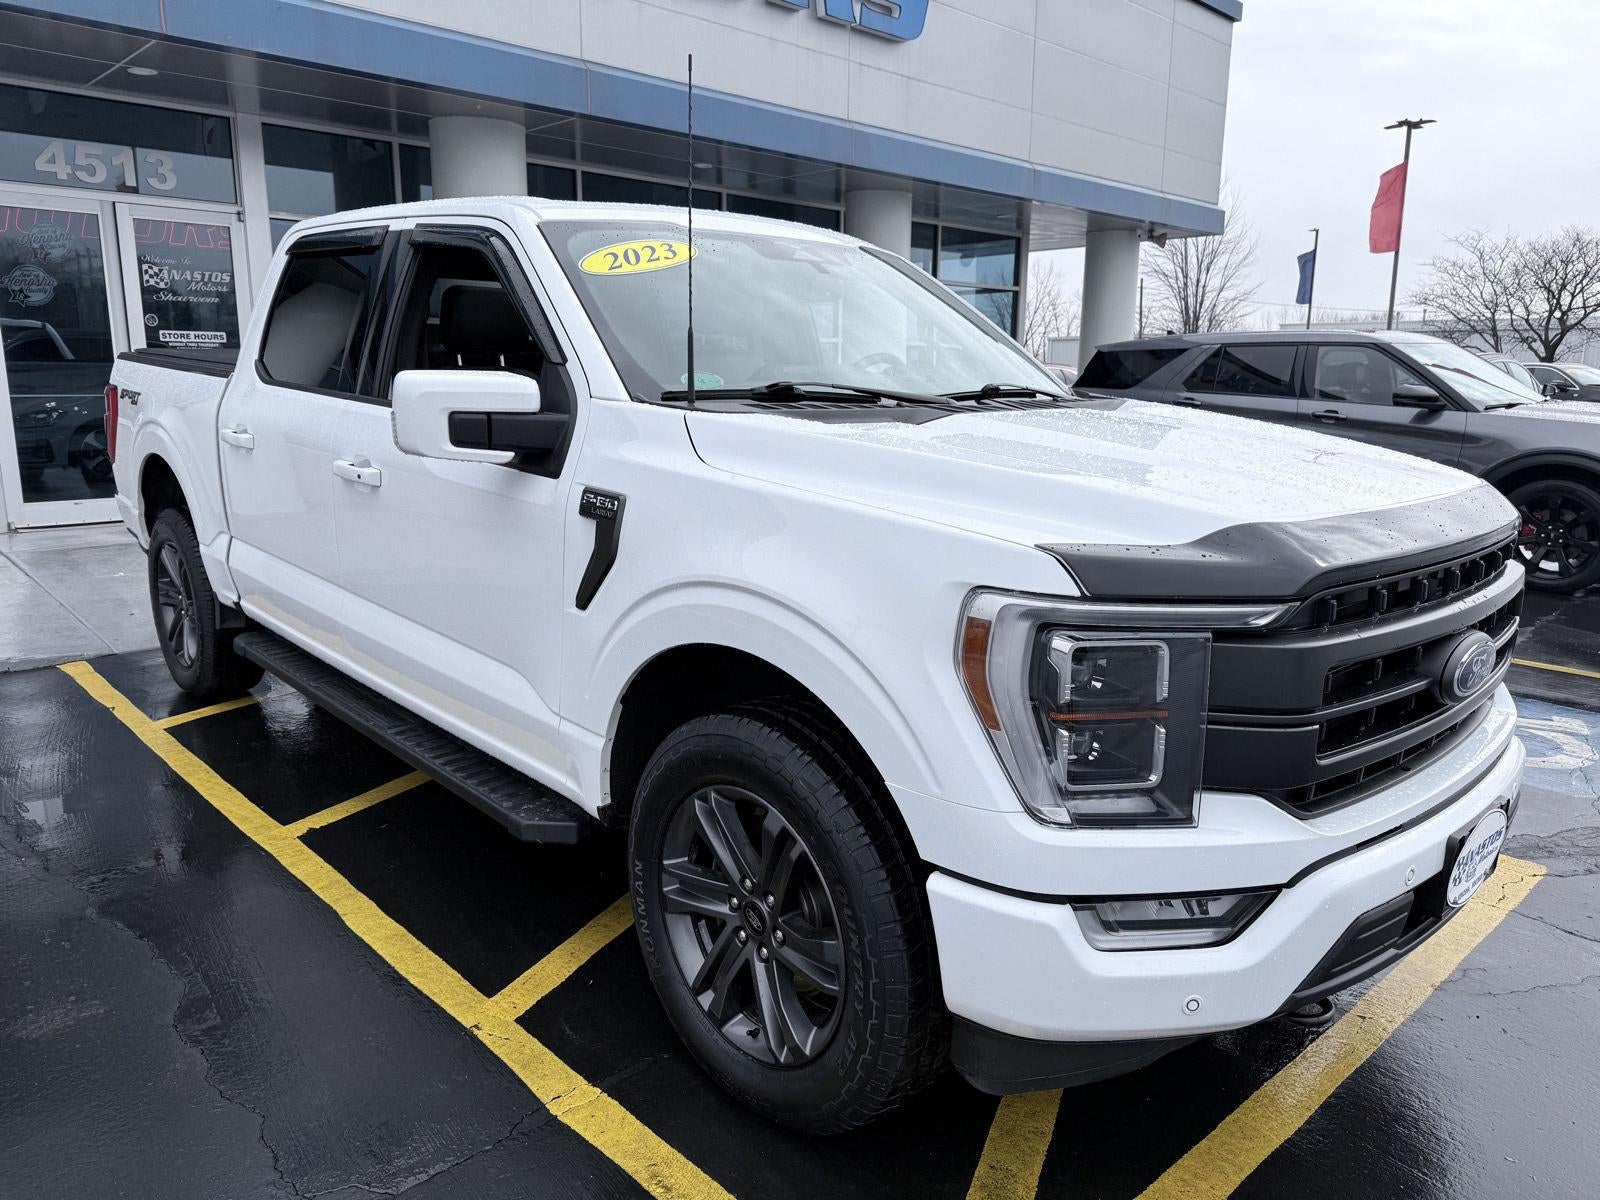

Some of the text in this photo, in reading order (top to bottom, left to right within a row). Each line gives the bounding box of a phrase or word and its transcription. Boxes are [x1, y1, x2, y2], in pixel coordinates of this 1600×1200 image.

[34, 141, 178, 191] 4513
[141, 254, 192, 265] Welcome To
[603, 242, 678, 272] 2023
[0, 274, 57, 288] Kenosha
[158, 270, 231, 283] ANASTOS
[187, 282, 230, 292] Motors
[153, 291, 220, 303] Showroom
[161, 332, 191, 340] STORE
